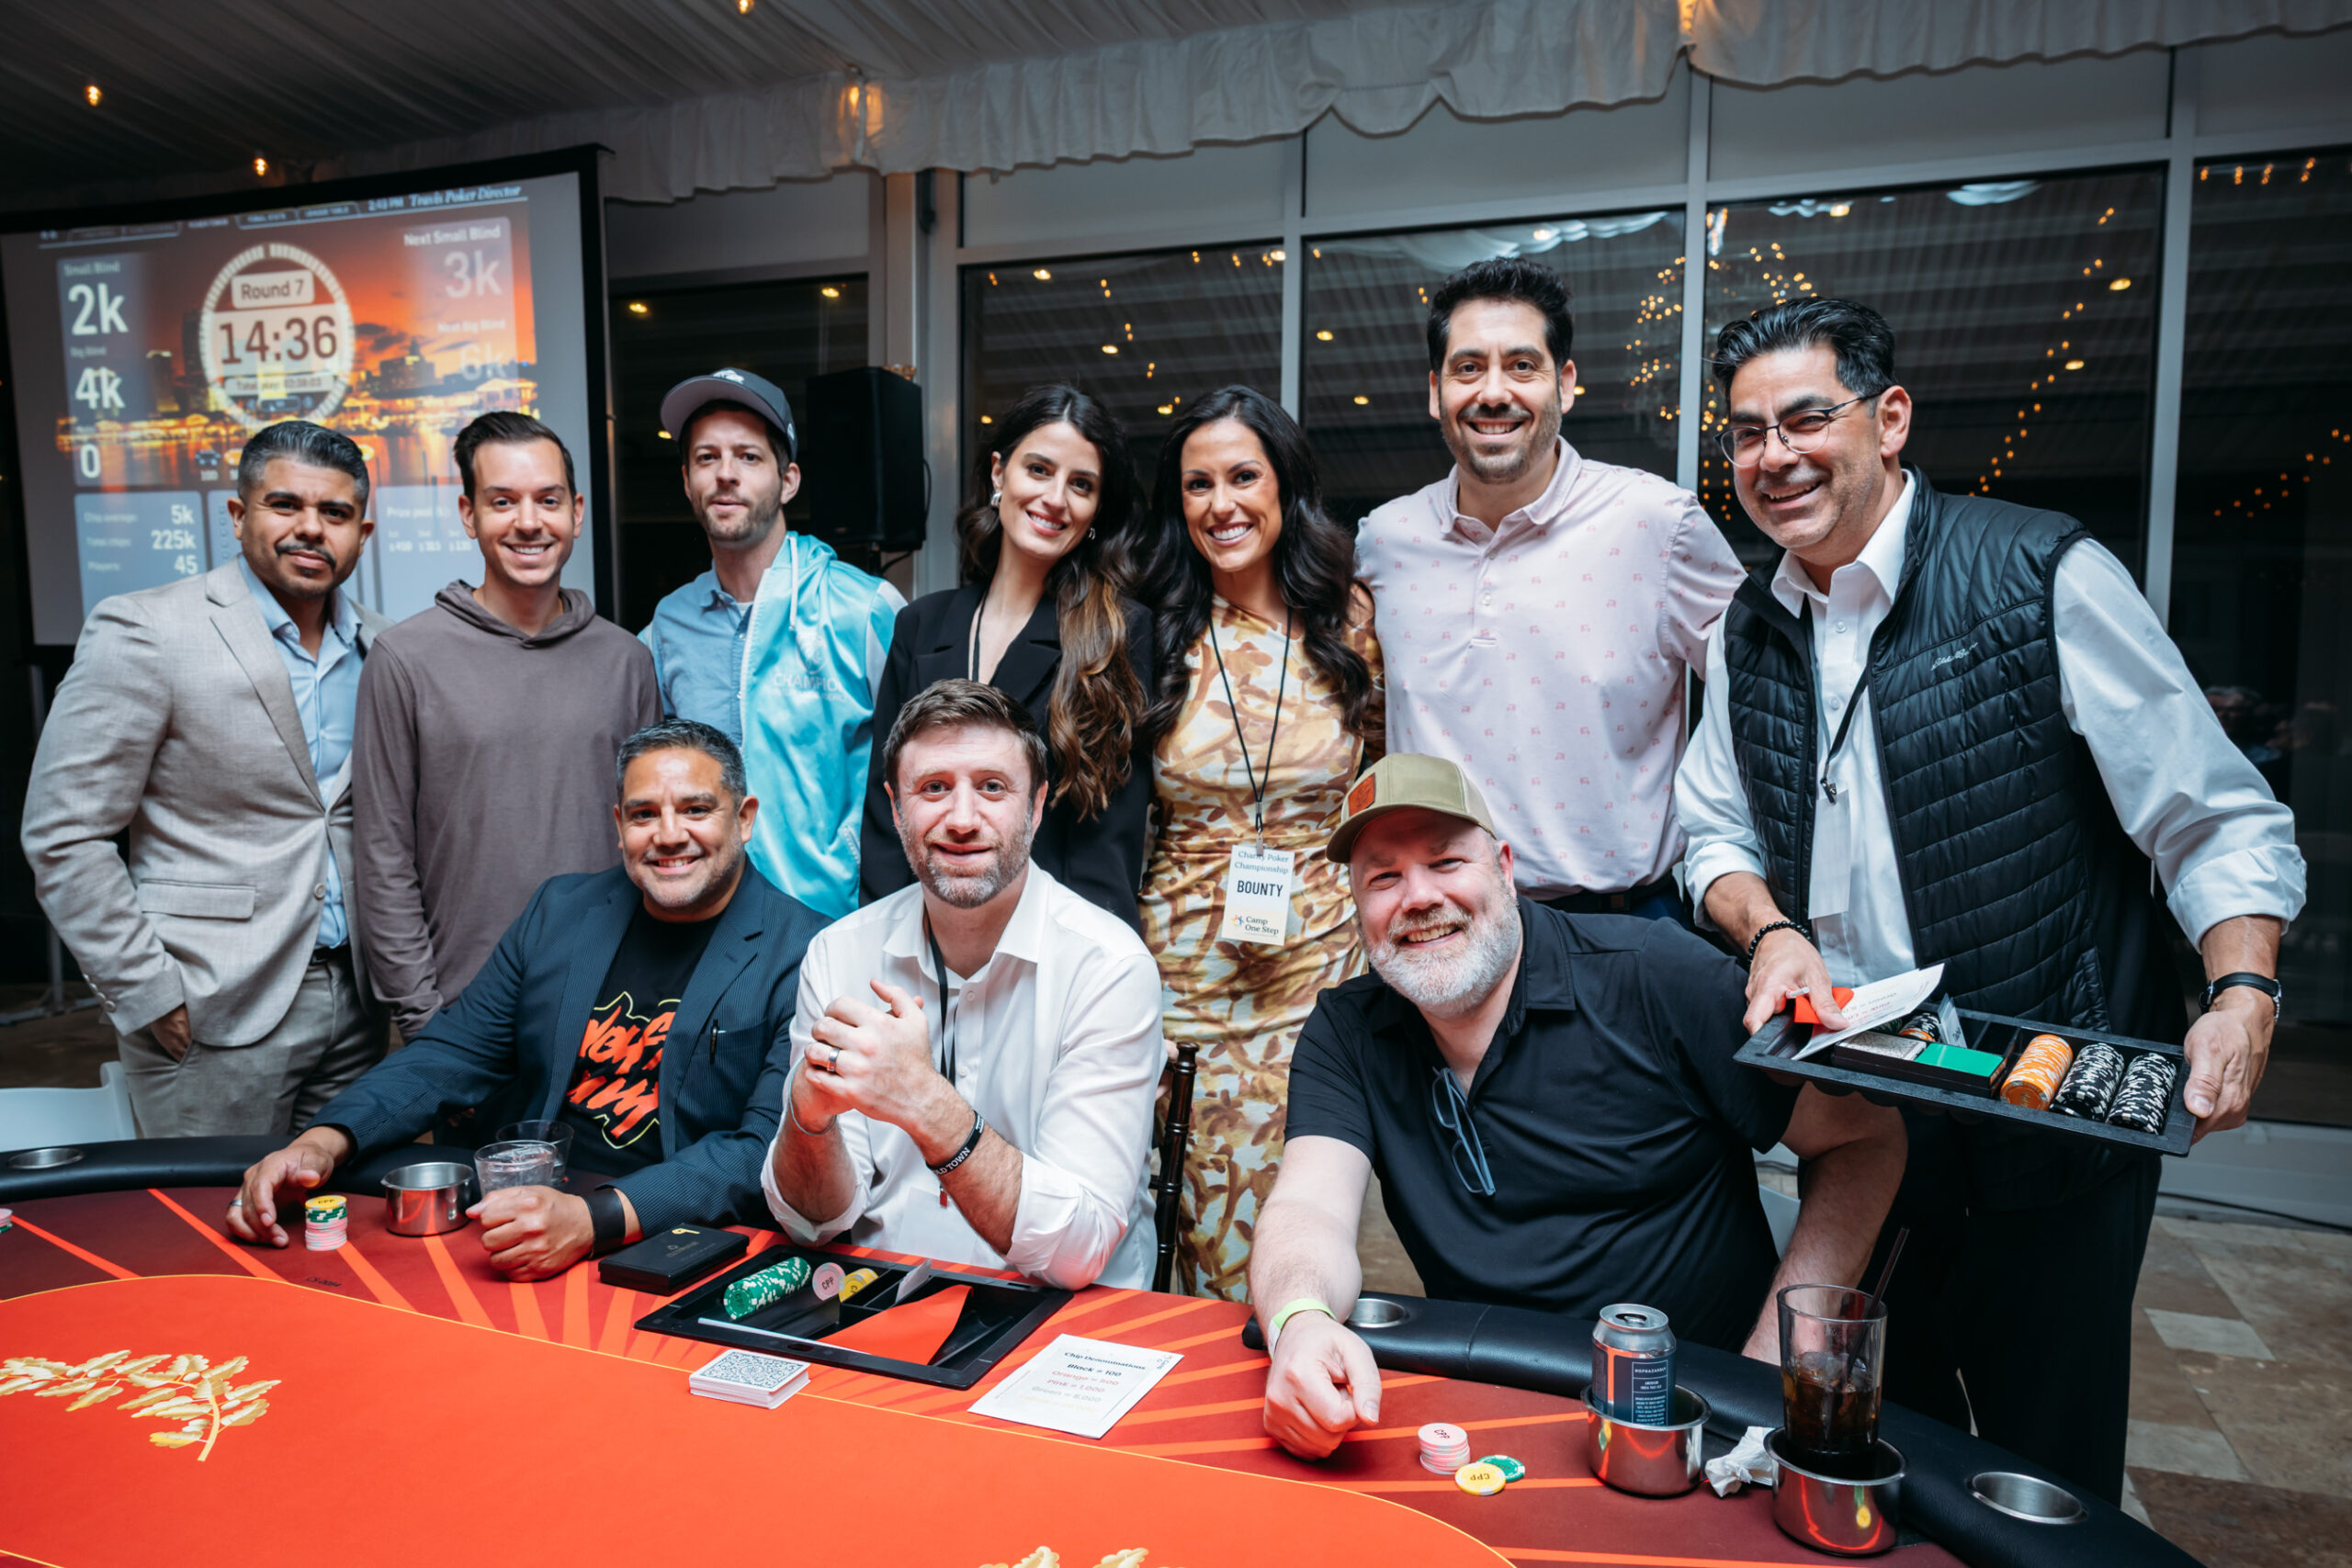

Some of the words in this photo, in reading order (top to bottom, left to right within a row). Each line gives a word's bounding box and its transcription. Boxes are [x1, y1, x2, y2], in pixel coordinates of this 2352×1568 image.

[445, 186, 476, 203] Poker
[477, 185, 522, 200] Director
[404, 232, 431, 246] Next
[434, 229, 468, 244] Small
[469, 225, 501, 241] Blind
[444, 249, 503, 299] 3k
[241, 281, 290, 300] Round
[295, 278, 304, 296] 7
[68, 283, 129, 335] 2k
[220, 316, 337, 365] 14:36
[459, 342, 506, 381] 6k
[75, 367, 125, 410] 4k
[80, 444, 101, 479] 0
[171, 504, 195, 525] 5k
[151, 529, 197, 550] 225k
[174, 555, 198, 575] 45
[774, 672, 842, 692] CHAMPIO
[1234, 862, 1289, 874] Championship
[1267, 853, 1290, 863] Poker
[1237, 880, 1283, 897] BOUNTY
[1245, 924, 1261, 932] One
[1261, 926, 1279, 935] Step
[1246, 916, 1268, 926] Camp
[945, 1146, 971, 1169] TOWN
[821, 1277, 834, 1290] CPP
[1051, 1371, 1089, 1382] Orange
[1067, 1363, 1093, 1373] Black
[1032, 1386, 1062, 1397] Green
[1046, 1379, 1068, 1388] Pink
[1433, 1428, 1451, 1439] CPP
